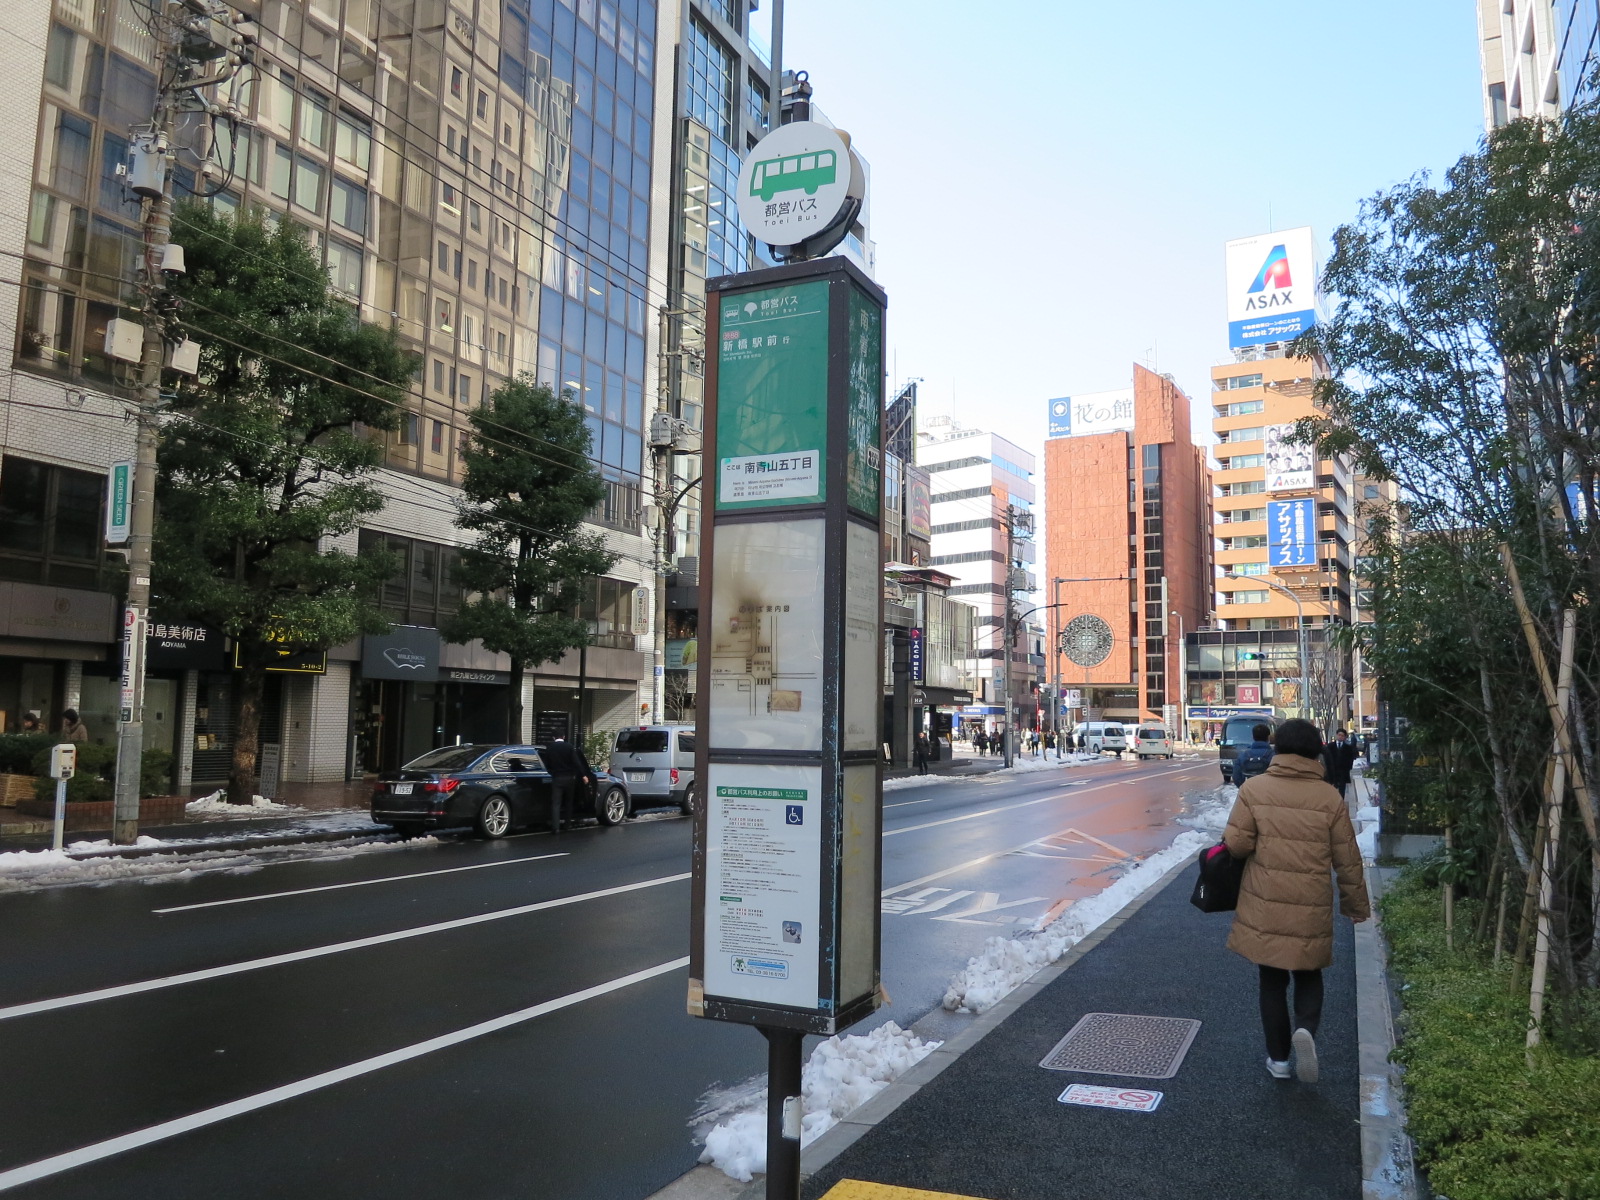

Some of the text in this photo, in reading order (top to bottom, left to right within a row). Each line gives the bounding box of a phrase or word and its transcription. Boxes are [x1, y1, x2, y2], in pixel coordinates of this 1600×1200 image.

[764, 197, 818, 217] 都営バス
[764, 214, 818, 227] Toei Bus
[761, 295, 799, 310] 都営バス
[1245, 290, 1293, 311] ASAX
[1267, 323, 1301, 336] アサックス
[723, 334, 791, 352] 新橋駅前 行
[1073, 399, 1133, 425] 花の館
[744, 456, 812, 475] 南青山五丁目
[1283, 477, 1308, 486] ASAX
[117, 478, 125, 504] GREEN
[1277, 502, 1292, 565] アサックス
[161, 641, 187, 650] AOYAMA
[727, 787, 783, 798] 都営バス利用上のお願い
